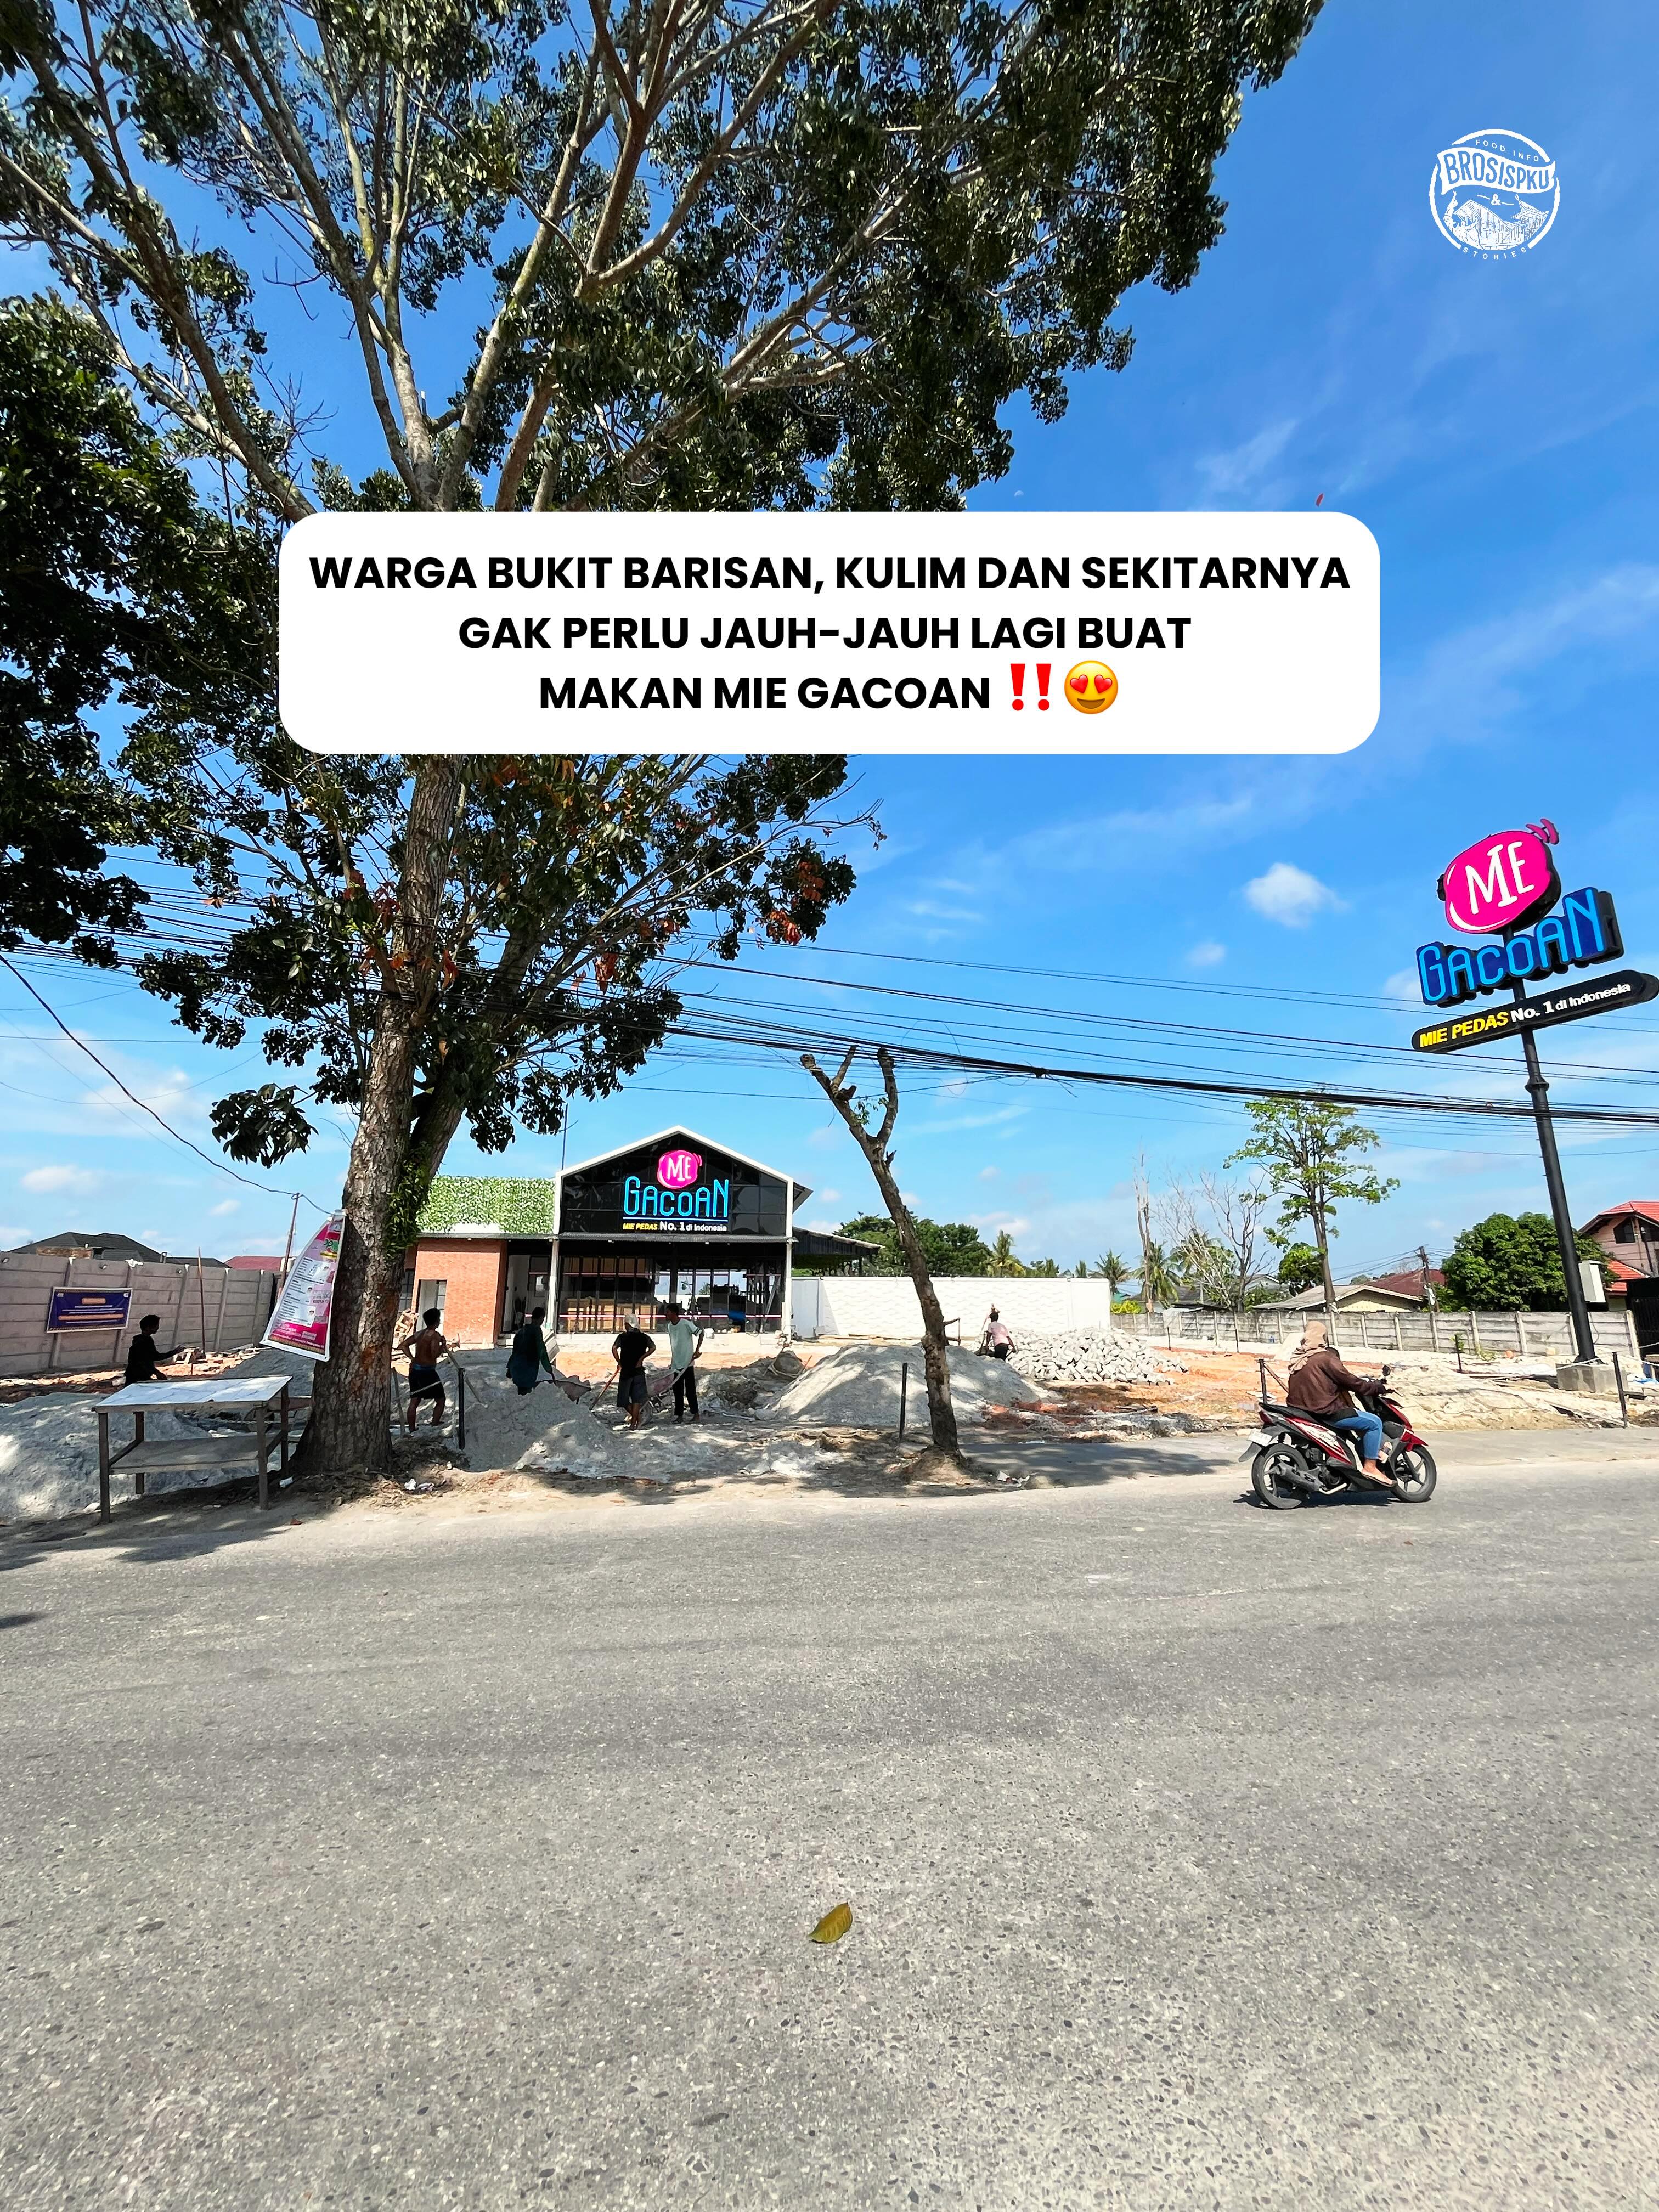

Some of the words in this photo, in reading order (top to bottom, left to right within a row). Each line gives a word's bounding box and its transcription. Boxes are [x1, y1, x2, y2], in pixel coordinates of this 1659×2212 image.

[1419, 889, 1605, 1002] GACOAN
[1420, 1028, 1448, 1047] MIE
[1452, 1011, 1510, 1039] PEDAS
[1510, 1007, 1541, 1023] No.
[1543, 1001, 1555, 1014] 1
[1569, 983, 1631, 1007] Indonesia
[624, 1176, 729, 1218] GACOAN
[659, 1221, 677, 1231] No.
[680, 1222, 685, 1231] 1
[694, 1223, 727, 1232] Indonesia
